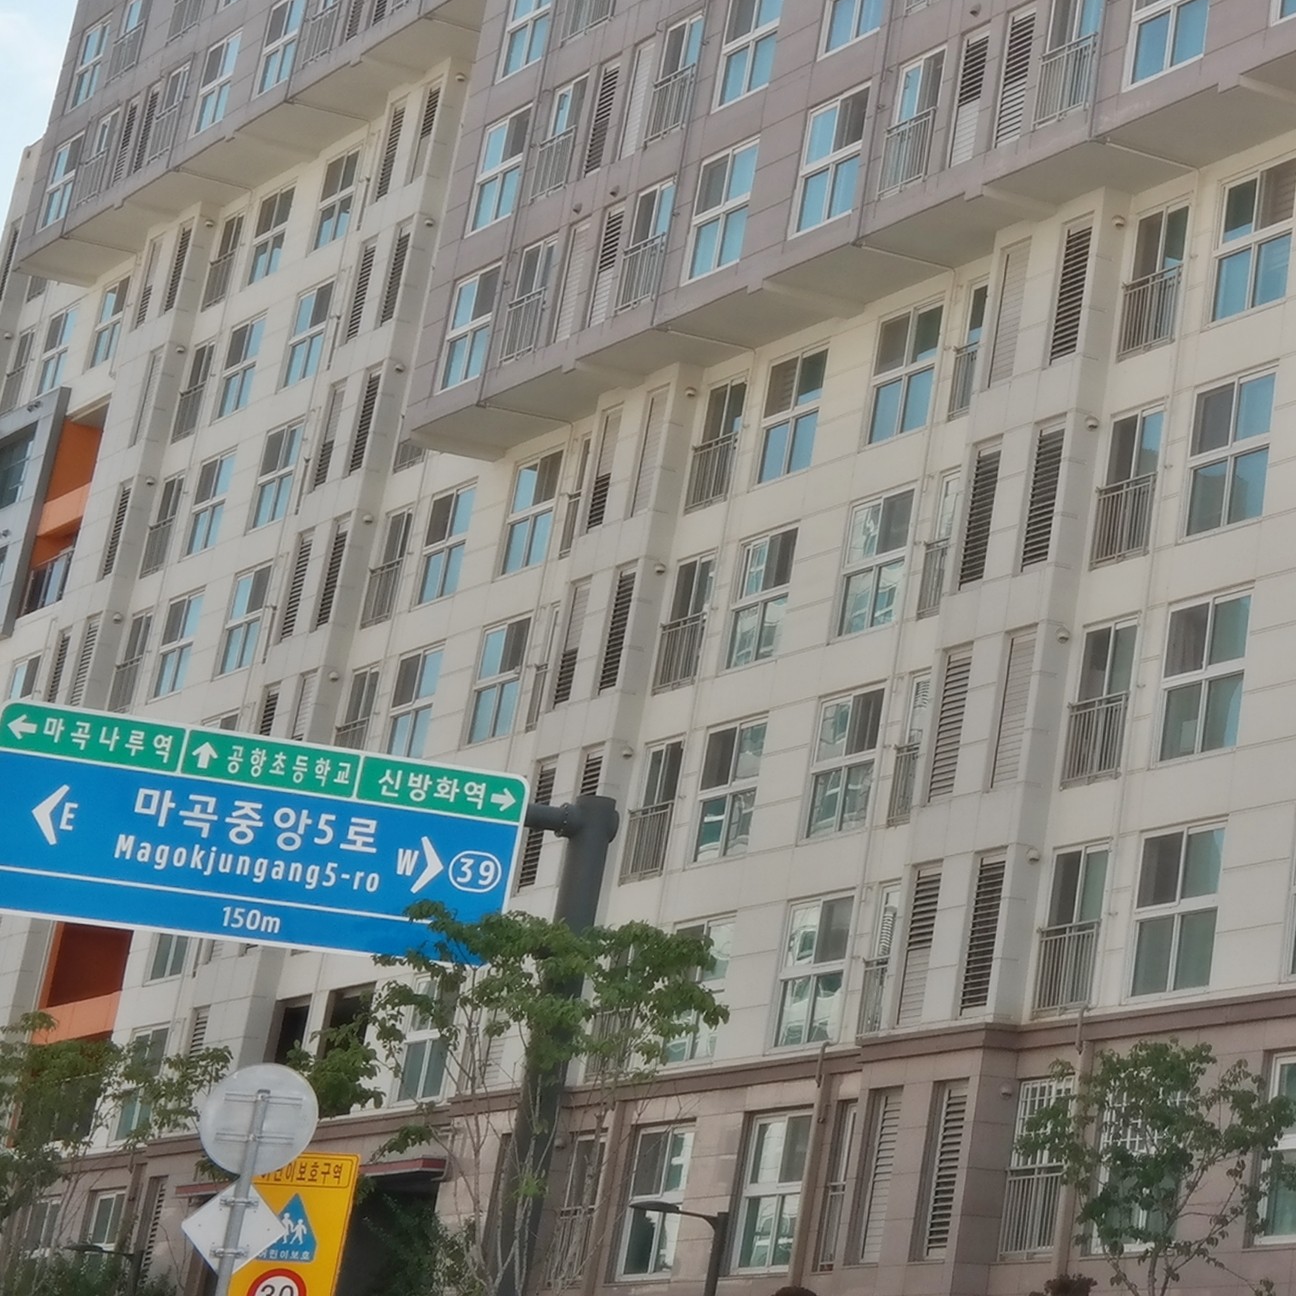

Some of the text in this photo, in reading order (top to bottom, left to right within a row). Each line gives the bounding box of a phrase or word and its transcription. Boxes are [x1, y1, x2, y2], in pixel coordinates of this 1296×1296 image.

[43, 717, 174, 764] 마곡나루역
[226, 745, 352, 787] 공항초등학교
[377, 769, 487, 811] 신방화역
[59, 802, 79, 831] E
[134, 787, 378, 855] 마곡중앙5로
[114, 834, 380, 892] Magokjungang5-ro
[396, 847, 420, 877] W
[455, 856, 497, 887] 39
[221, 906, 282, 934] 150m
